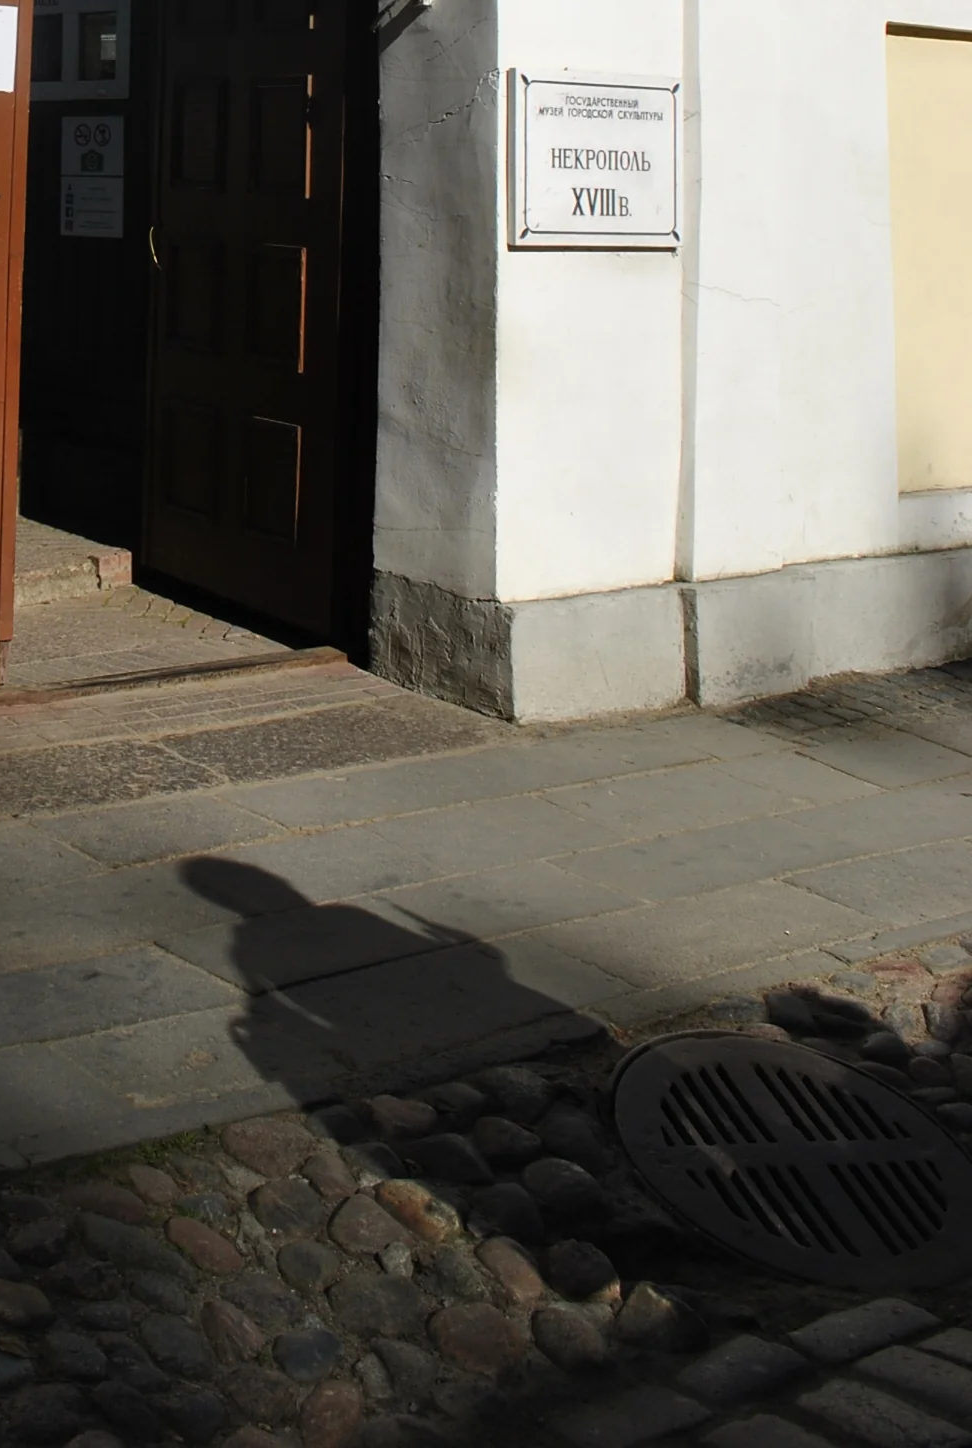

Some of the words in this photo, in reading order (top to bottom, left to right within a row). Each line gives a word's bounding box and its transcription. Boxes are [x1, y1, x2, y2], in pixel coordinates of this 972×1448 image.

[565, 95, 639, 109] ГОСУДАРСТВЕННЫЙ
[538, 106, 564, 117] МУЗЕЙ
[567, 107, 613, 119] ГОРОДСКОЙ
[617, 109, 664, 121] СКУЛЬПТУРЫ
[550, 148, 651, 172] НЕКРОПОЛЬ
